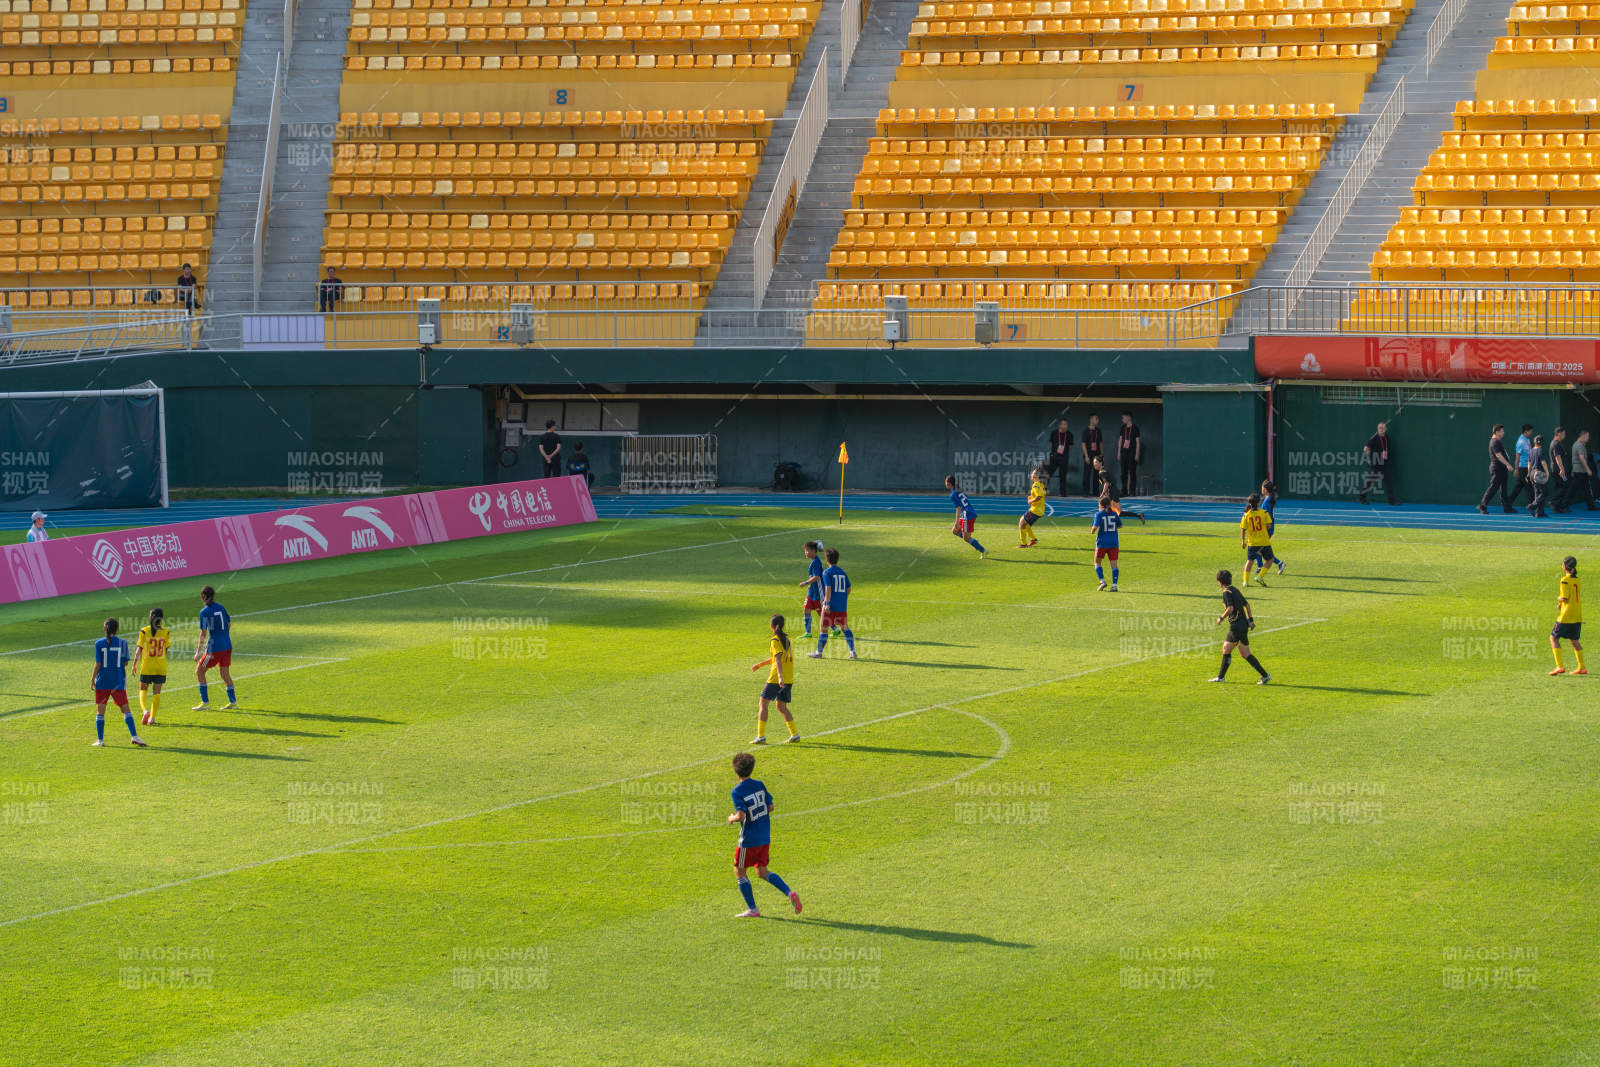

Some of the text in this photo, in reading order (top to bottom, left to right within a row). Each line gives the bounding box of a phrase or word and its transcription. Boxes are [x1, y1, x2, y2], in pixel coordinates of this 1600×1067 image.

[556, 89, 568, 105] 8
[1125, 84, 1135, 100] 7
[1007, 324, 1018, 341] 7
[1563, 362, 1583, 371] 2025
[496, 486, 552, 519] 中国电信
[958, 492, 969, 507] 2
[503, 514, 556, 528] CHINA TELECOM
[1102, 515, 1116, 532] 15
[1249, 515, 1262, 532] 13
[123, 532, 182, 559] 中国移动
[283, 537, 312, 560] ANTA
[351, 528, 379, 550] ANTA
[130, 555, 188, 576] China Mobile
[833, 574, 846, 593] 10
[214, 611, 225, 630] 7
[101, 647, 122, 668] 17
[743, 790, 768, 822] 29
